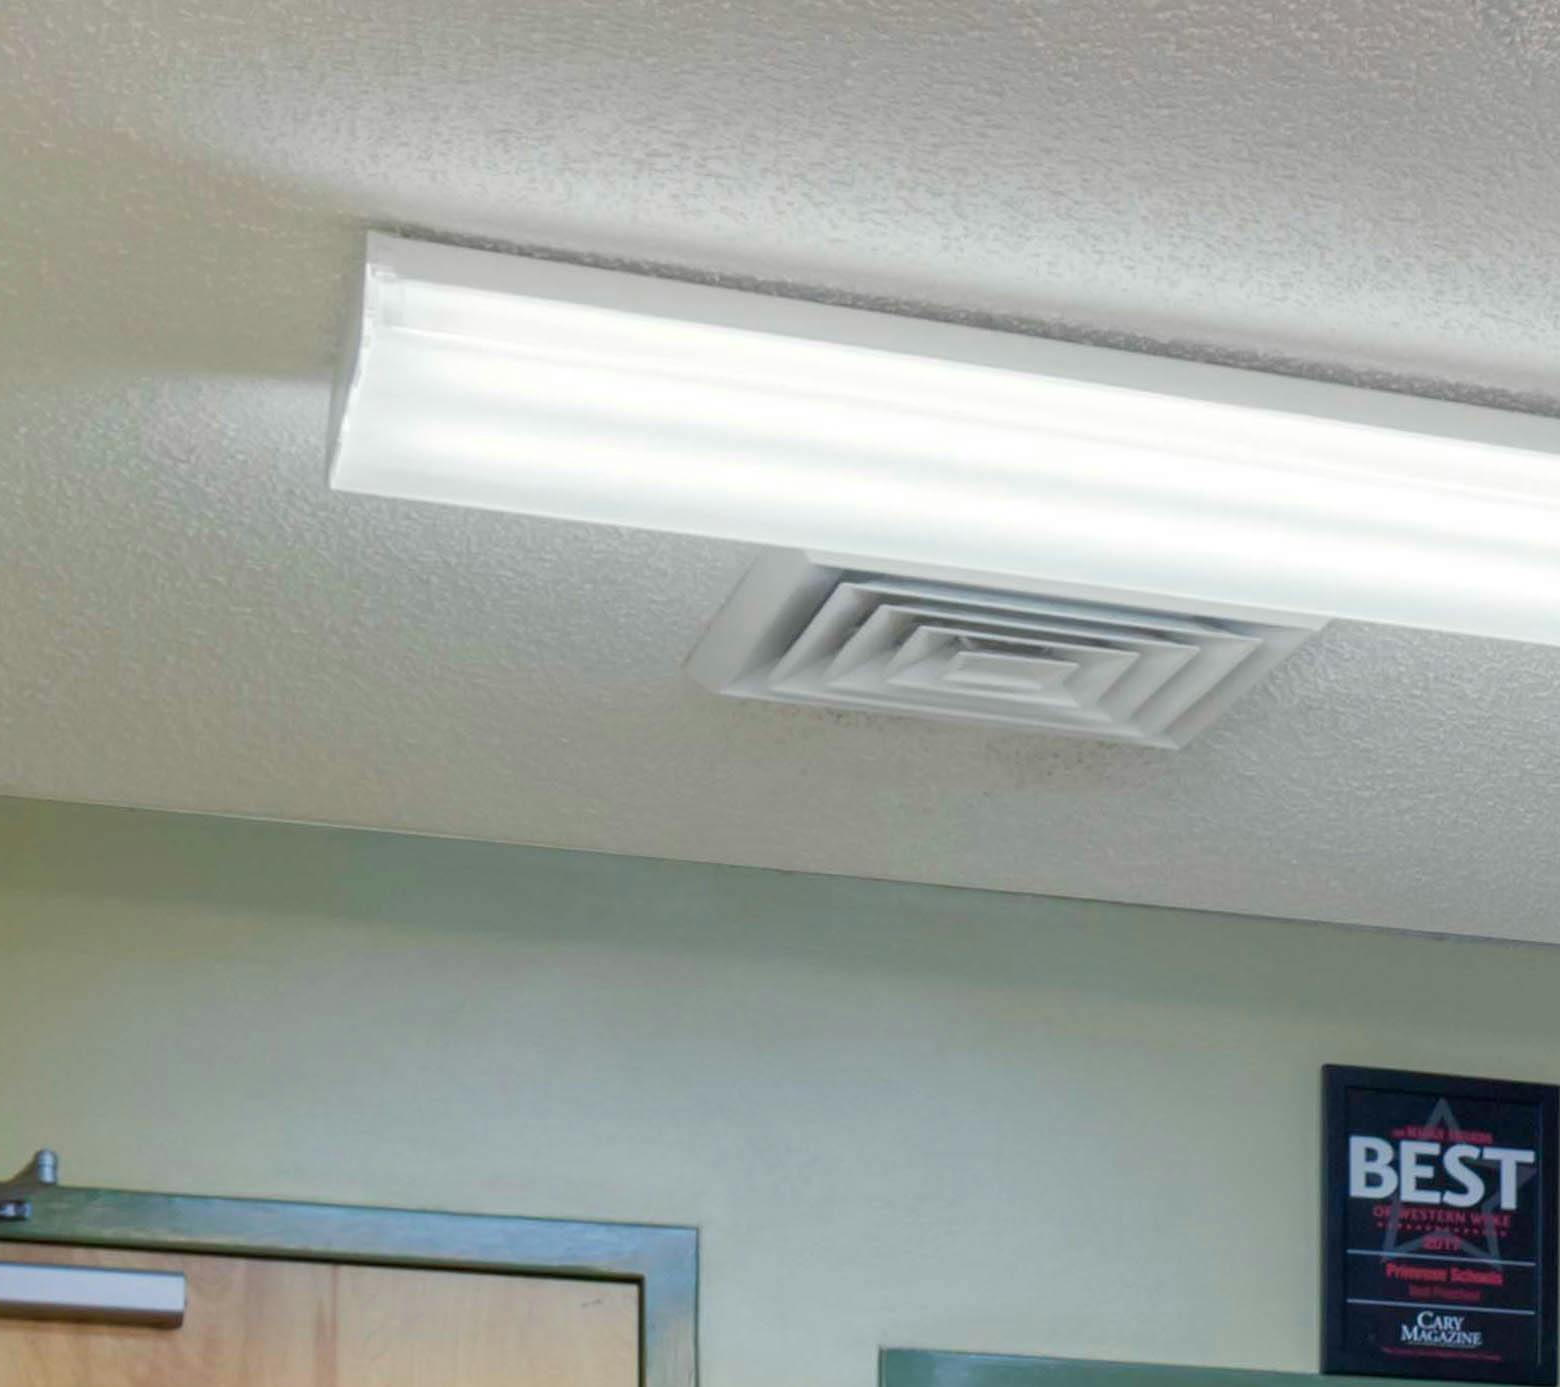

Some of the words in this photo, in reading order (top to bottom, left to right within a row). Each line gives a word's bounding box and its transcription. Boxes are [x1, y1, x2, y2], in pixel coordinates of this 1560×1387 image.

[1348, 1135, 1536, 1212] BEST
[1417, 1311, 1465, 1331] CARY
[1400, 1324, 1482, 1346] MAGAZINE
